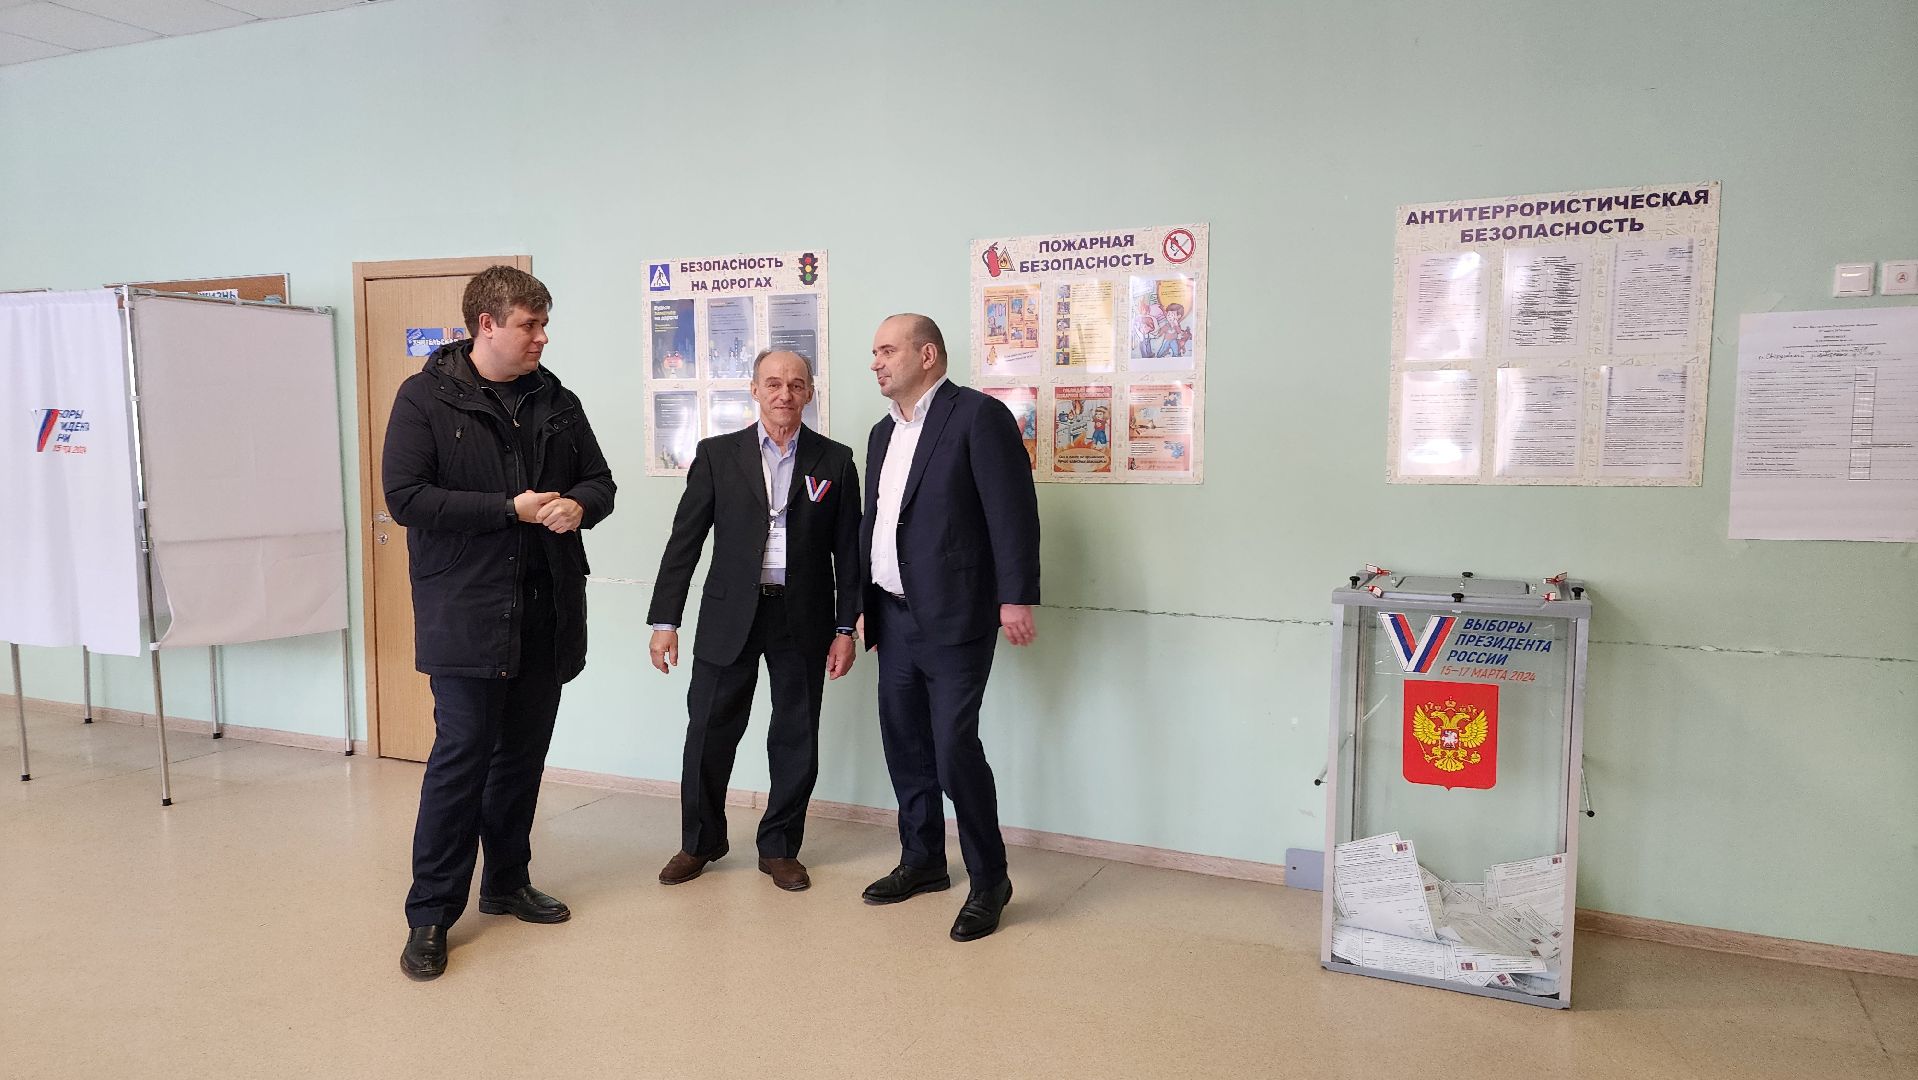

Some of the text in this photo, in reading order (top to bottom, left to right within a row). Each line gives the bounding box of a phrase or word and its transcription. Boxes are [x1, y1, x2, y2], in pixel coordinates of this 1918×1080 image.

[1406, 189, 1709, 226] АНТИТЕРРОРИСТИЧЕСКАЯ
[1460, 217, 1645, 244] БЕЗОПАСНОСТЬ
[1039, 234, 1135, 254] ПОЖАРНАЯ
[680, 256, 784, 273] БЕЗОПАСНОСТЬ
[1019, 253, 1155, 273] БЕЗОПАСНОСТЬ
[691, 276, 773, 292] НА ДОРОГАХ
[1463, 618, 1533, 634] ВЫБОРЫ
[1455, 634, 1552, 653] ПРЕЗИДЕНТА
[1447, 650, 1509, 666] РОССИИ
[1472, 667, 1507, 681] МАРТА
[1509, 671, 1536, 682] 2024
